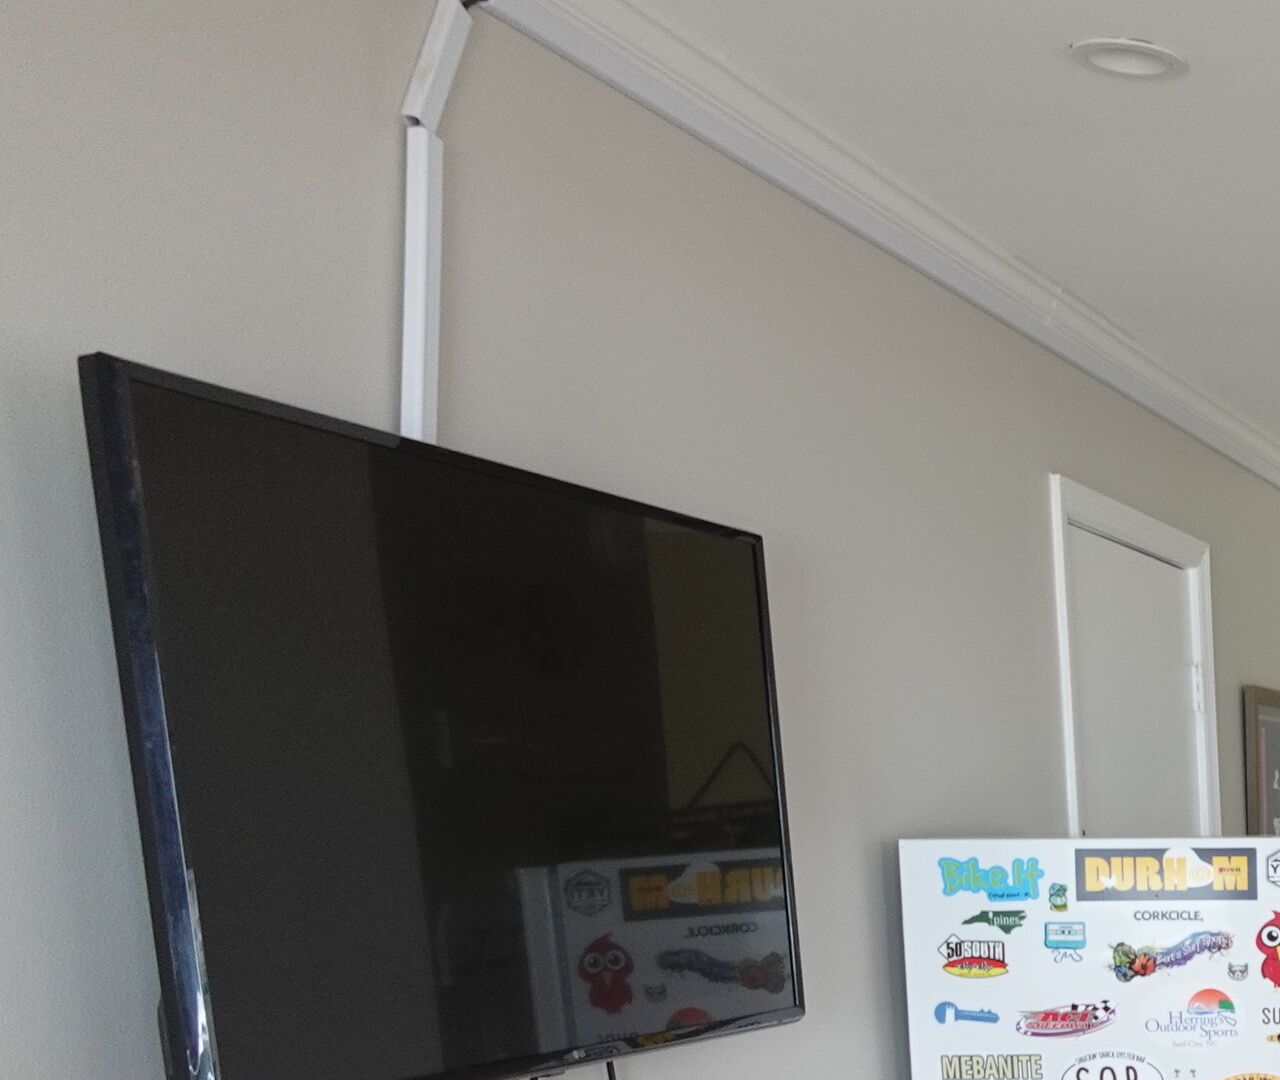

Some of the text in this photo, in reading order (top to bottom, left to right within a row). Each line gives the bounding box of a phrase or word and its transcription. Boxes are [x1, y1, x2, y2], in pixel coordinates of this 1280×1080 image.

[940, 858, 1044, 899] Bike It
[1084, 856, 1249, 892] DURHM
[946, 940, 1004, 961] 50 SOUTH
[1182, 941, 1202, 955] Surf
[1145, 1018, 1239, 1040] Outdoor Sports
[1168, 1011, 1226, 1028] Herring's
[1172, 1040, 1187, 1048] Surf
[1206, 1040, 1221, 1048] NC
[941, 1054, 1043, 1080] MEBANITE
